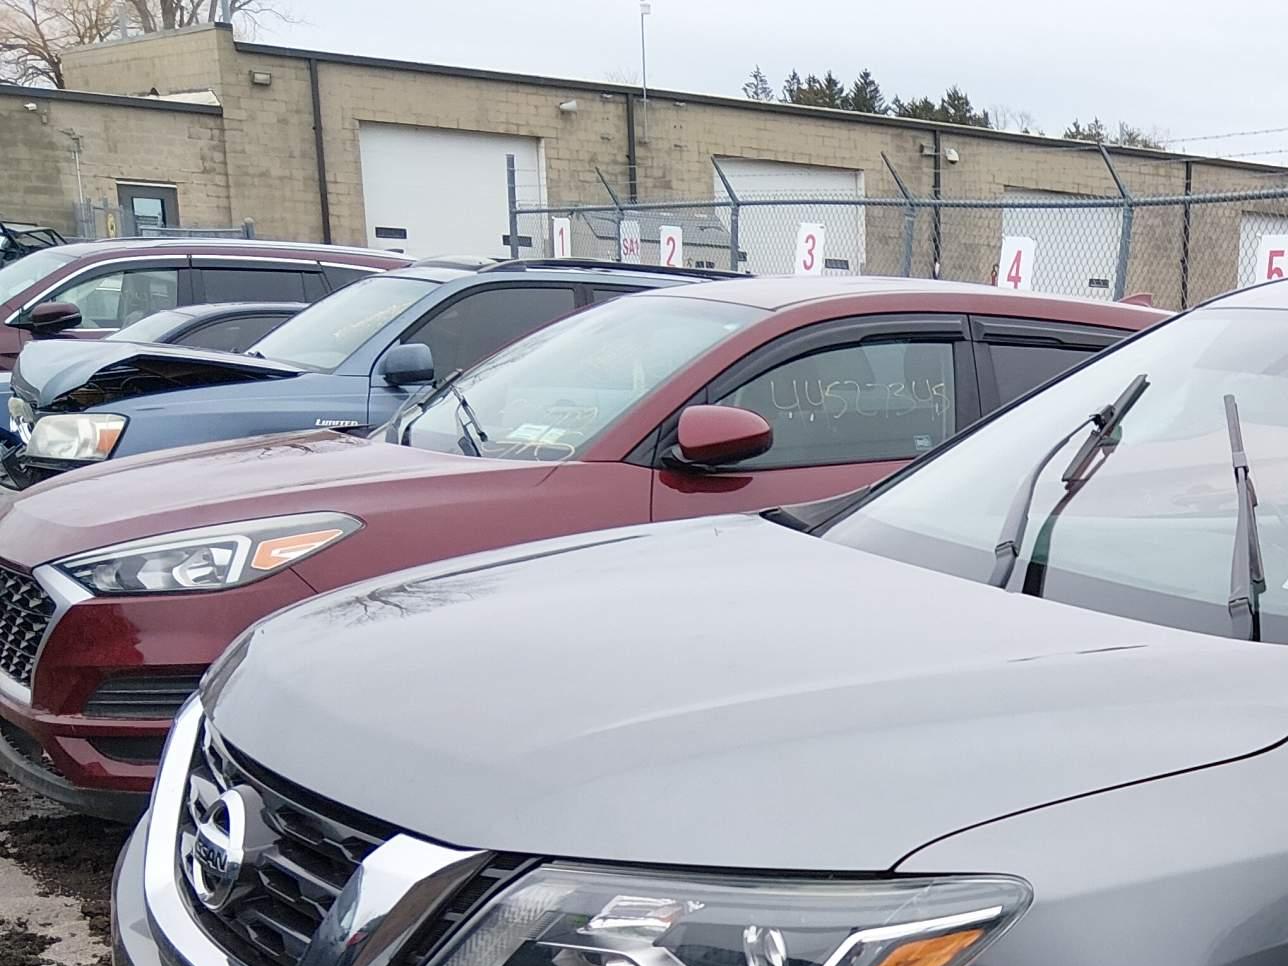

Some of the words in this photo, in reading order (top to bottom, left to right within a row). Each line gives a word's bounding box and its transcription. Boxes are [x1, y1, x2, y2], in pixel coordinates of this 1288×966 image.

[558, 227, 565, 257] 1
[666, 236, 677, 267] 2
[802, 233, 817, 271] 3
[1006, 249, 1023, 290] 4
[1267, 249, 1286, 280] 5
